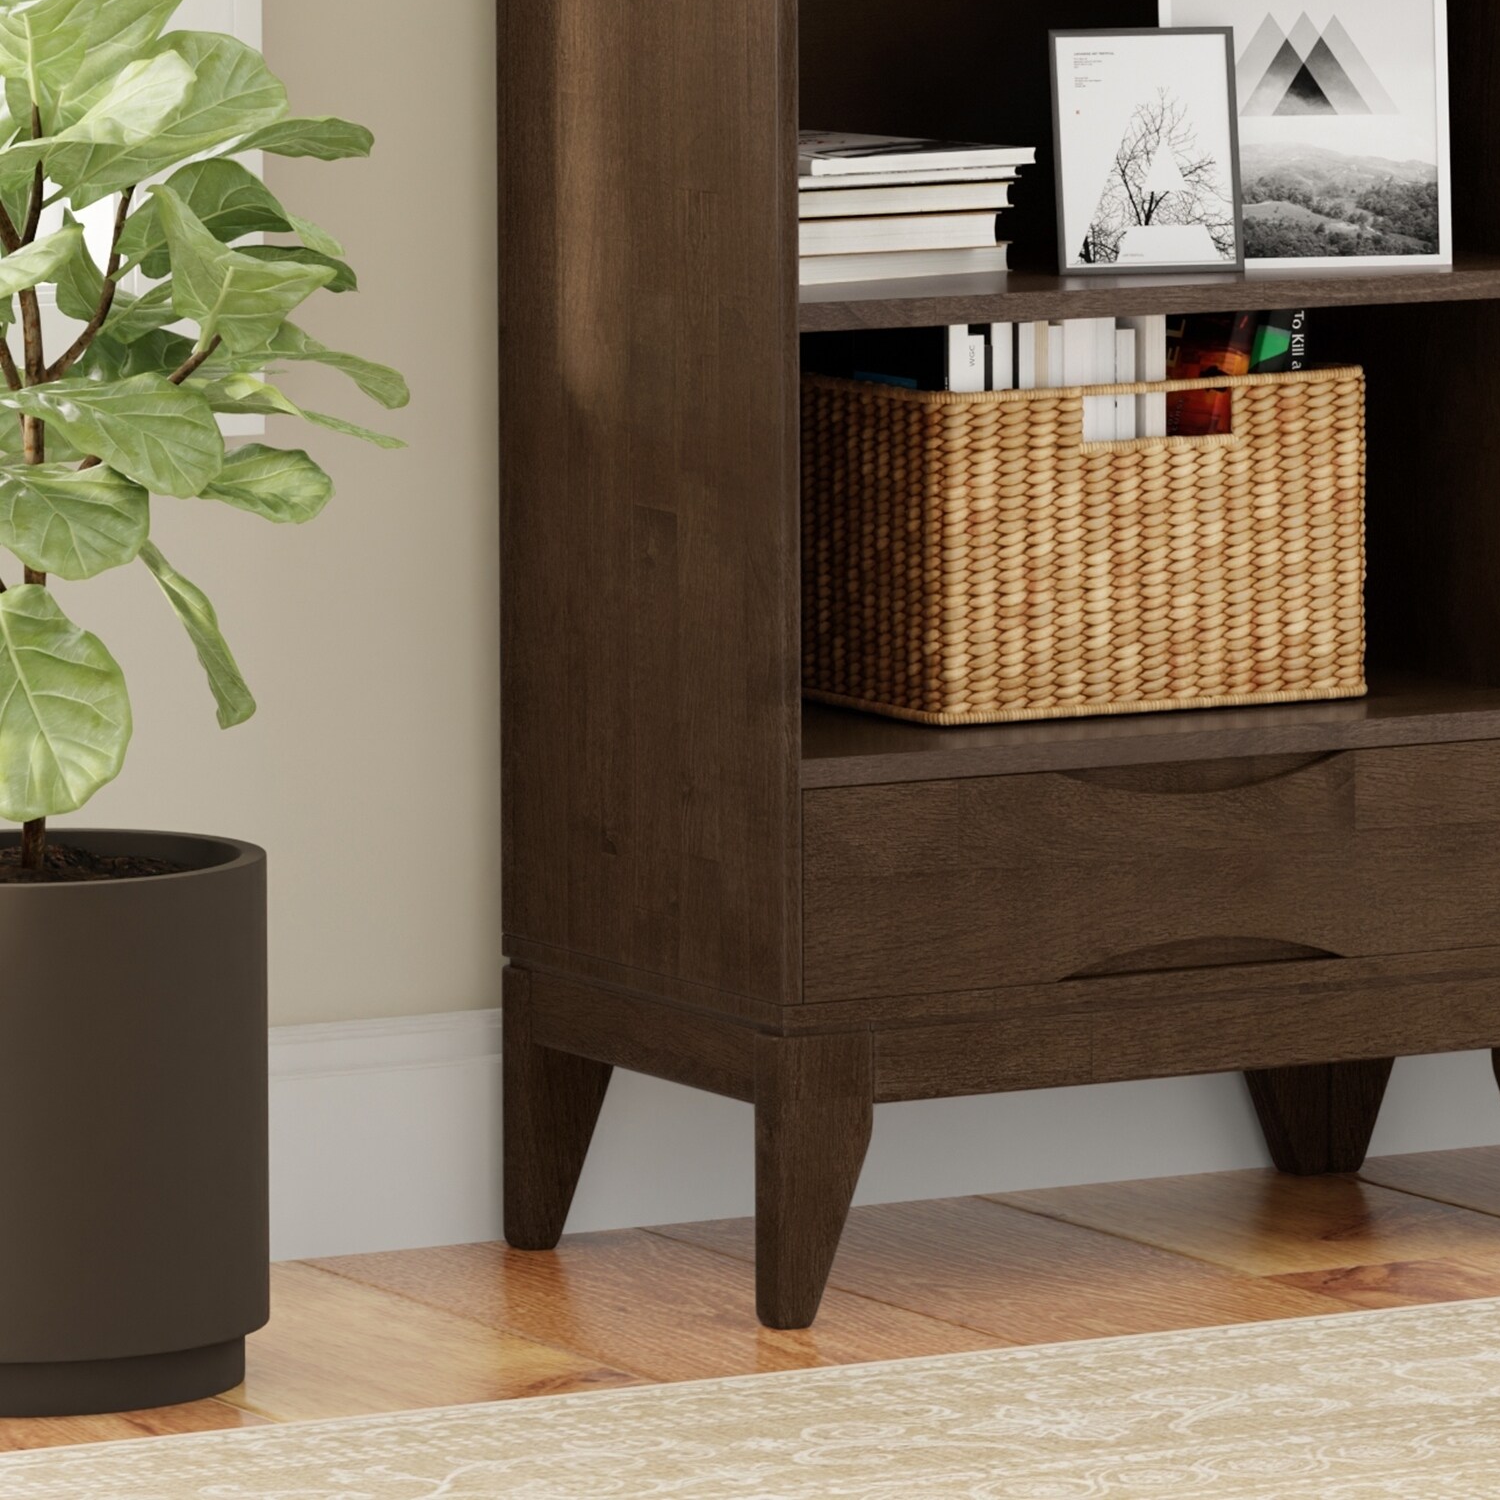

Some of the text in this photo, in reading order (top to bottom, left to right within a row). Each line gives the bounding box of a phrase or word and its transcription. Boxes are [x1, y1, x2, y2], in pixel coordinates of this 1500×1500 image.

[968, 344, 976, 368] WGC
[1292, 310, 1304, 371] To Kill a
